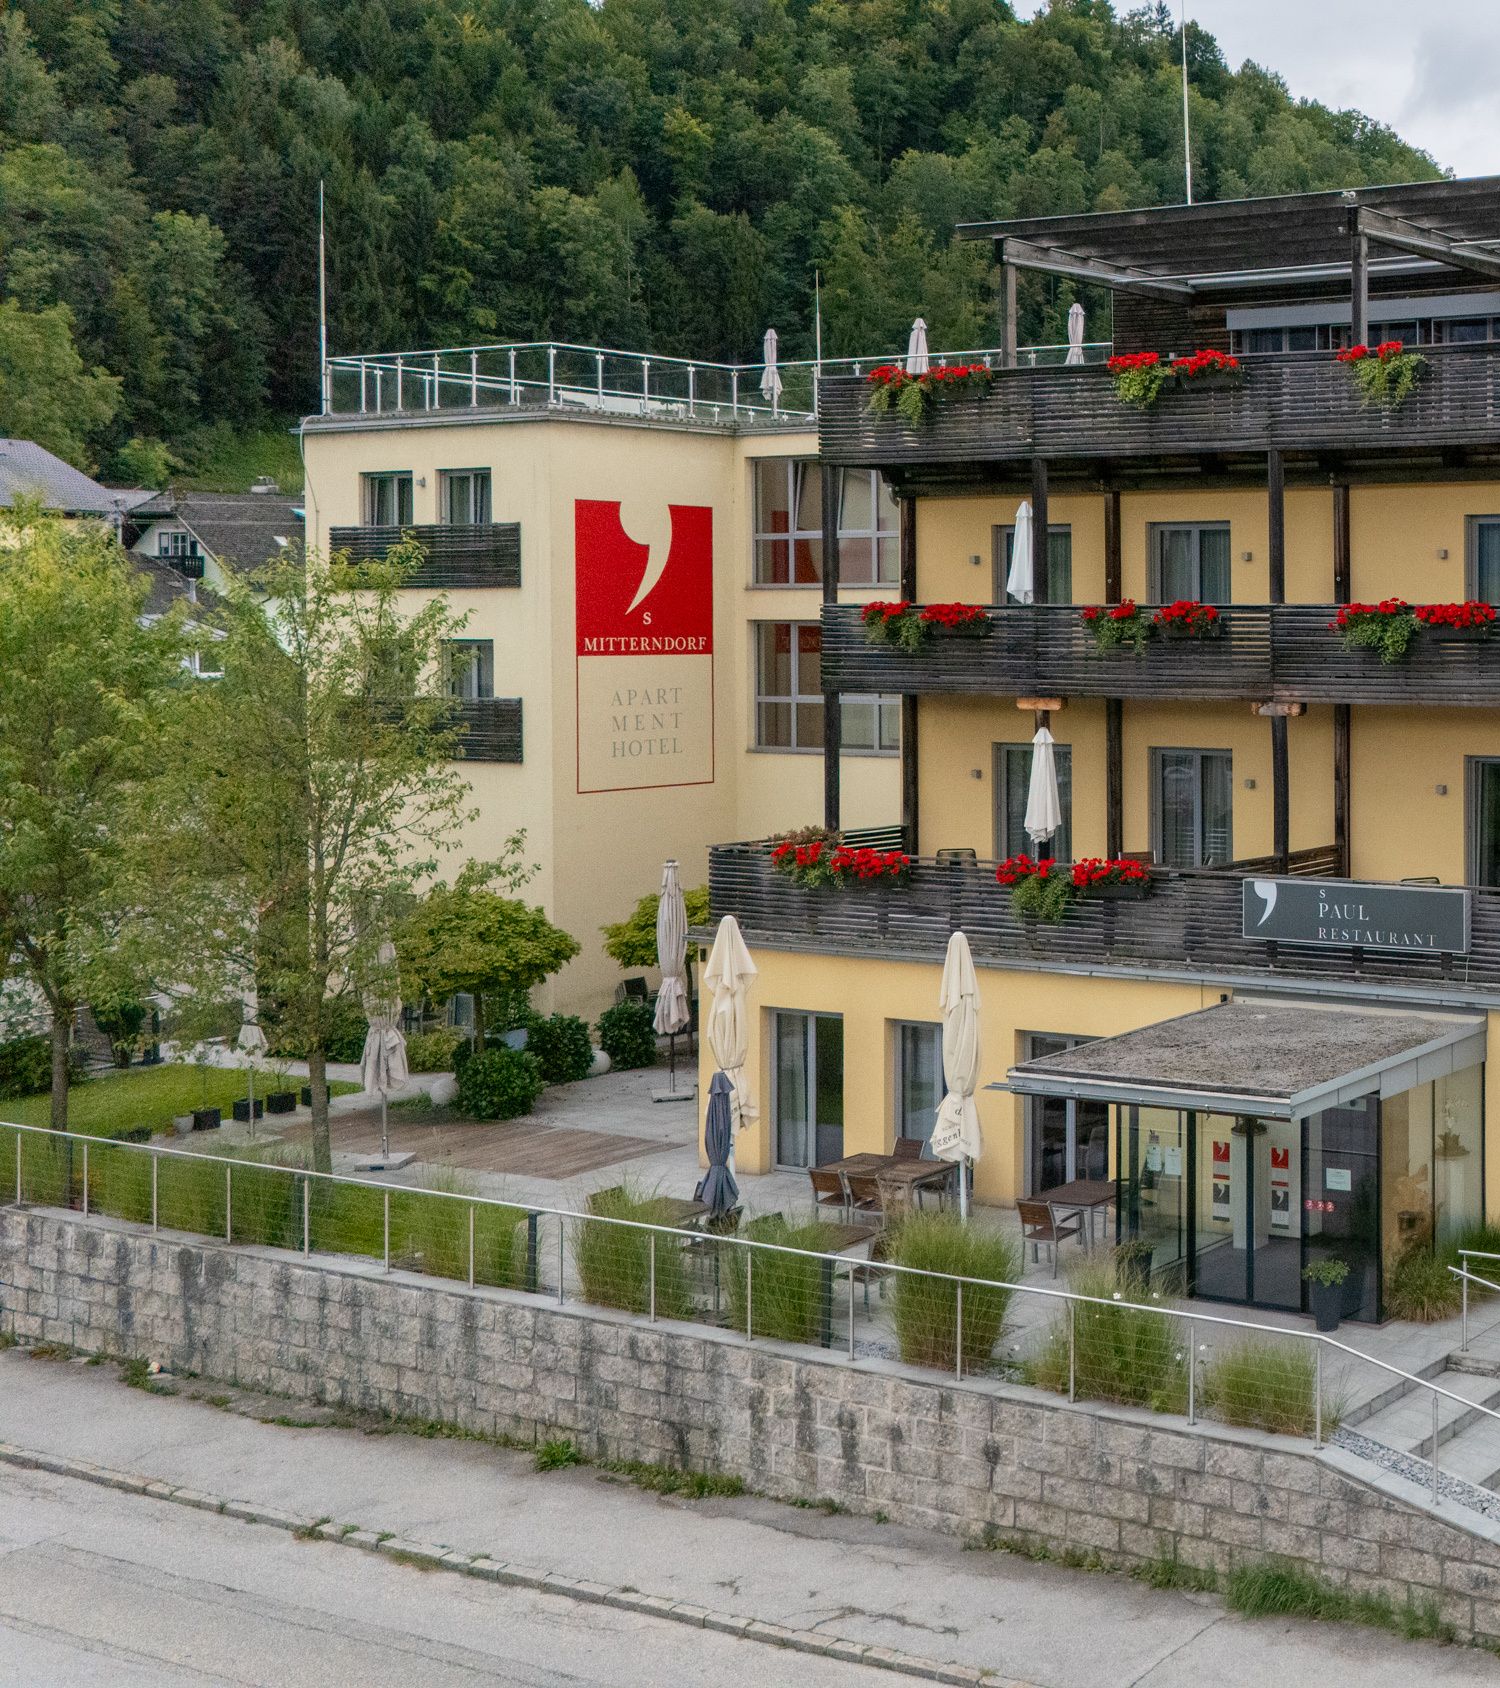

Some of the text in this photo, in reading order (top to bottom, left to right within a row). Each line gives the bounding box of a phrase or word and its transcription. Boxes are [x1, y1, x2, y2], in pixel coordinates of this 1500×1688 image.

[583, 636, 707, 652] MITTERNDORF
[611, 687, 683, 706] APART
[611, 712, 683, 733] MENT
[611, 737, 683, 758] HOTEL
[1318, 902, 1370, 921] PAUL
[1318, 926, 1438, 947] RESTAURANT
